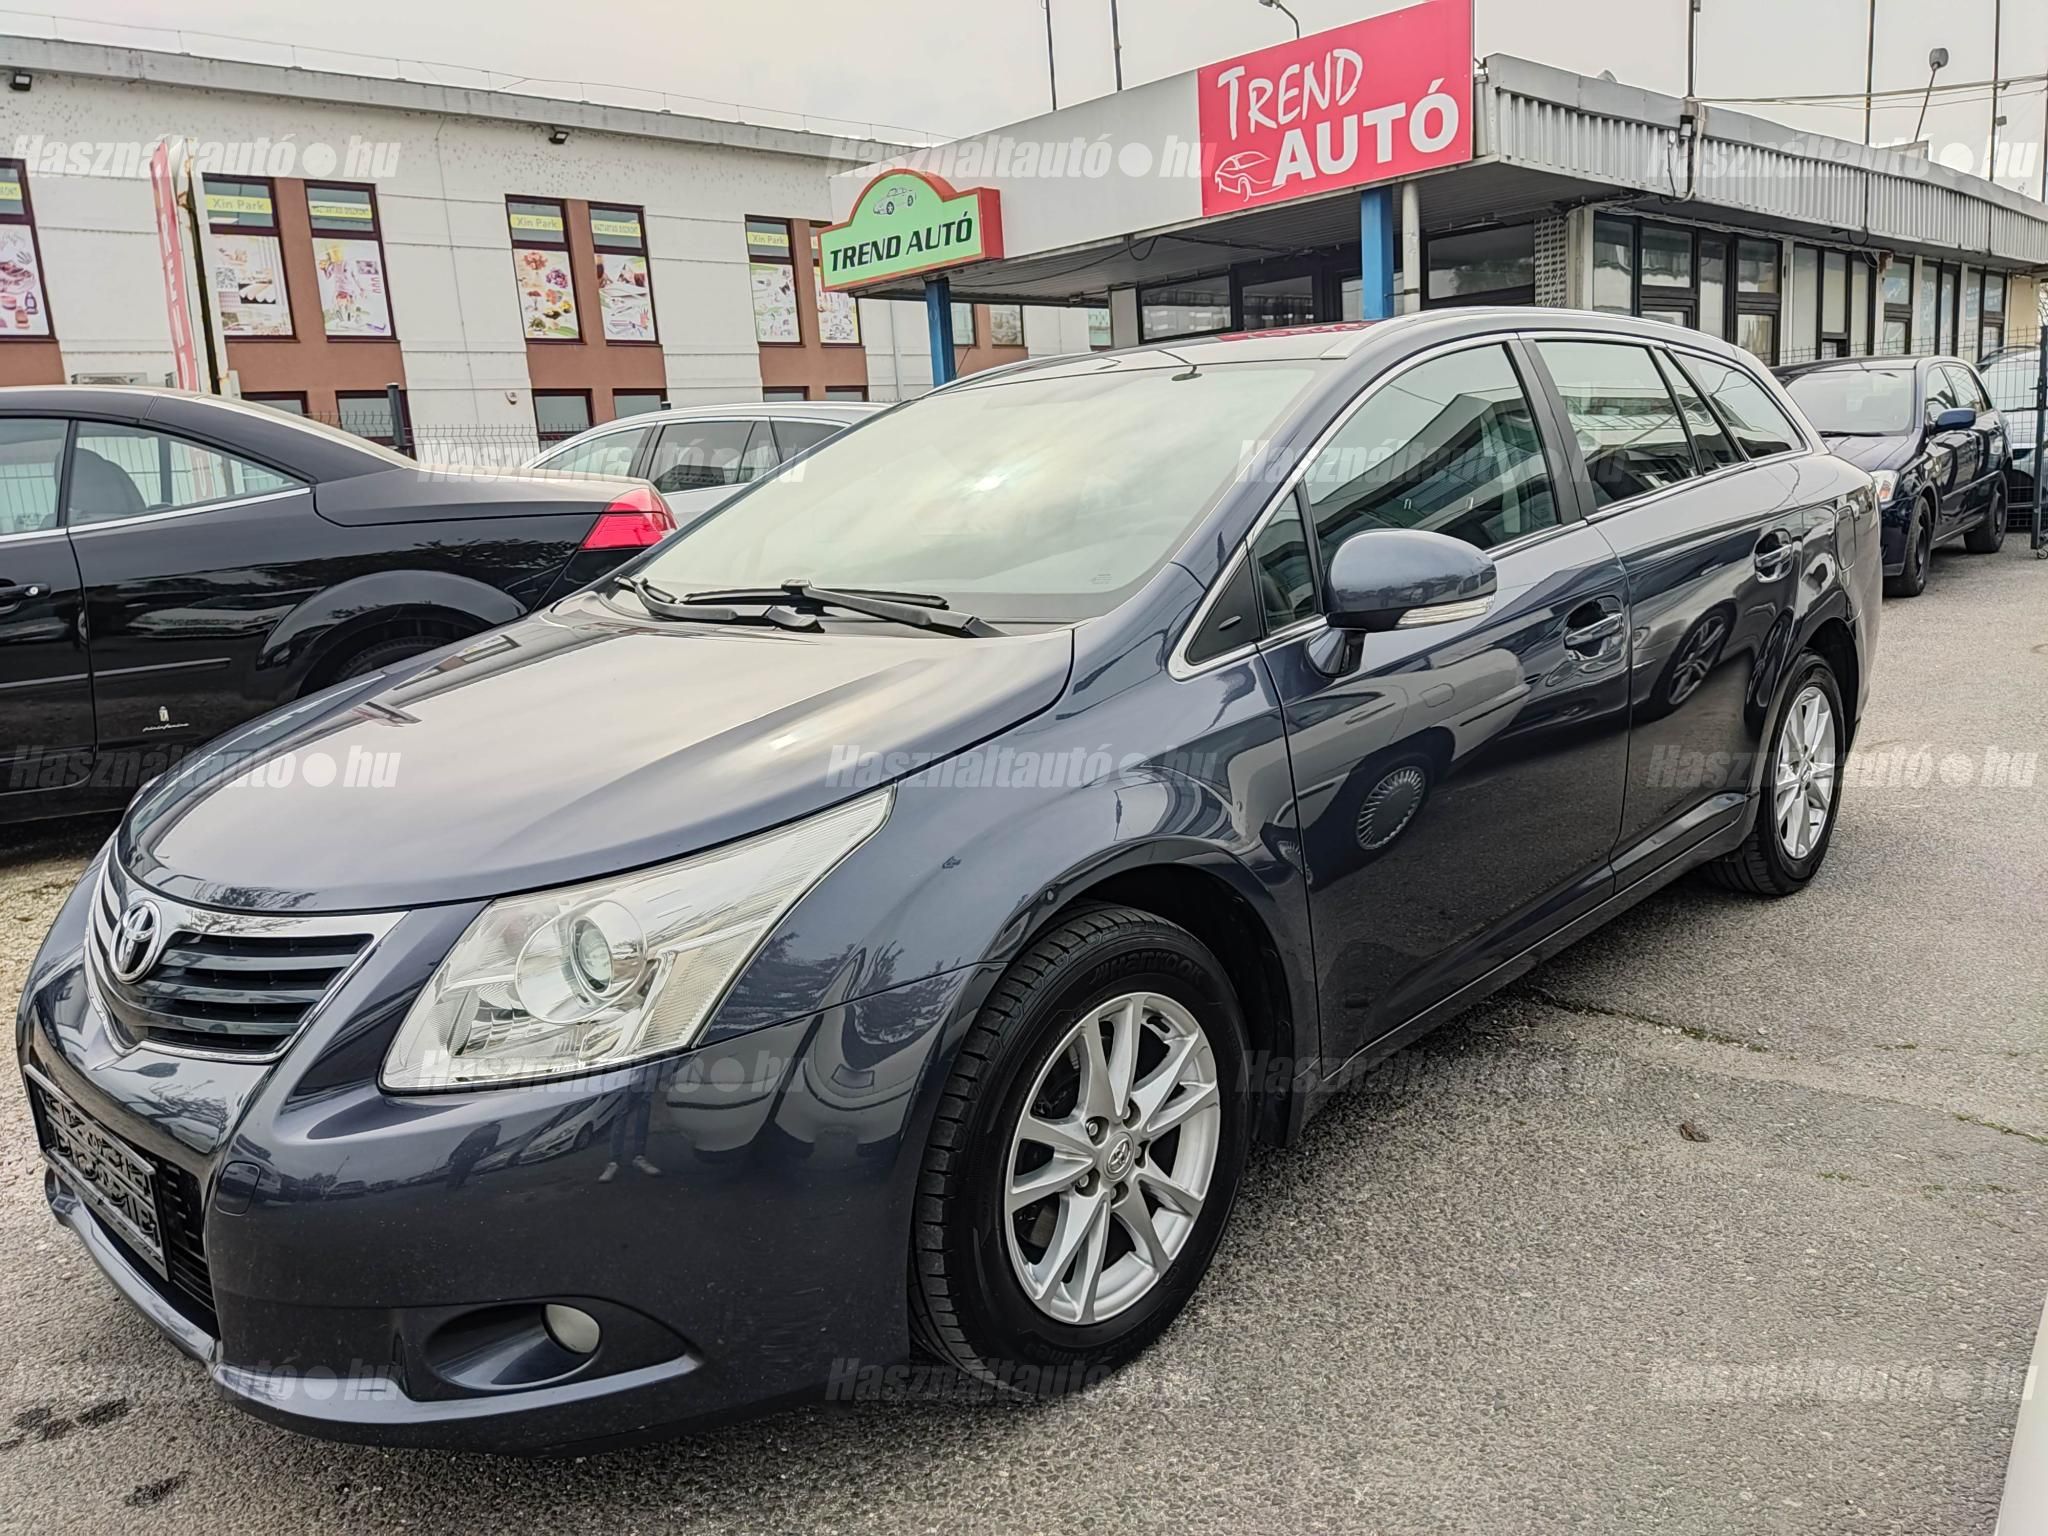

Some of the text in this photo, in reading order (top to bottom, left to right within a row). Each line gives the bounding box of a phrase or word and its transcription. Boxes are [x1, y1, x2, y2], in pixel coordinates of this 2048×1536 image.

[1217, 48, 1364, 141] TREND
[1271, 77, 1460, 188] AUTÓ
[212, 198, 265, 211] Xin Park
[536, 219, 558, 229] Park
[830, 211, 973, 272] TREND AUTÓ
